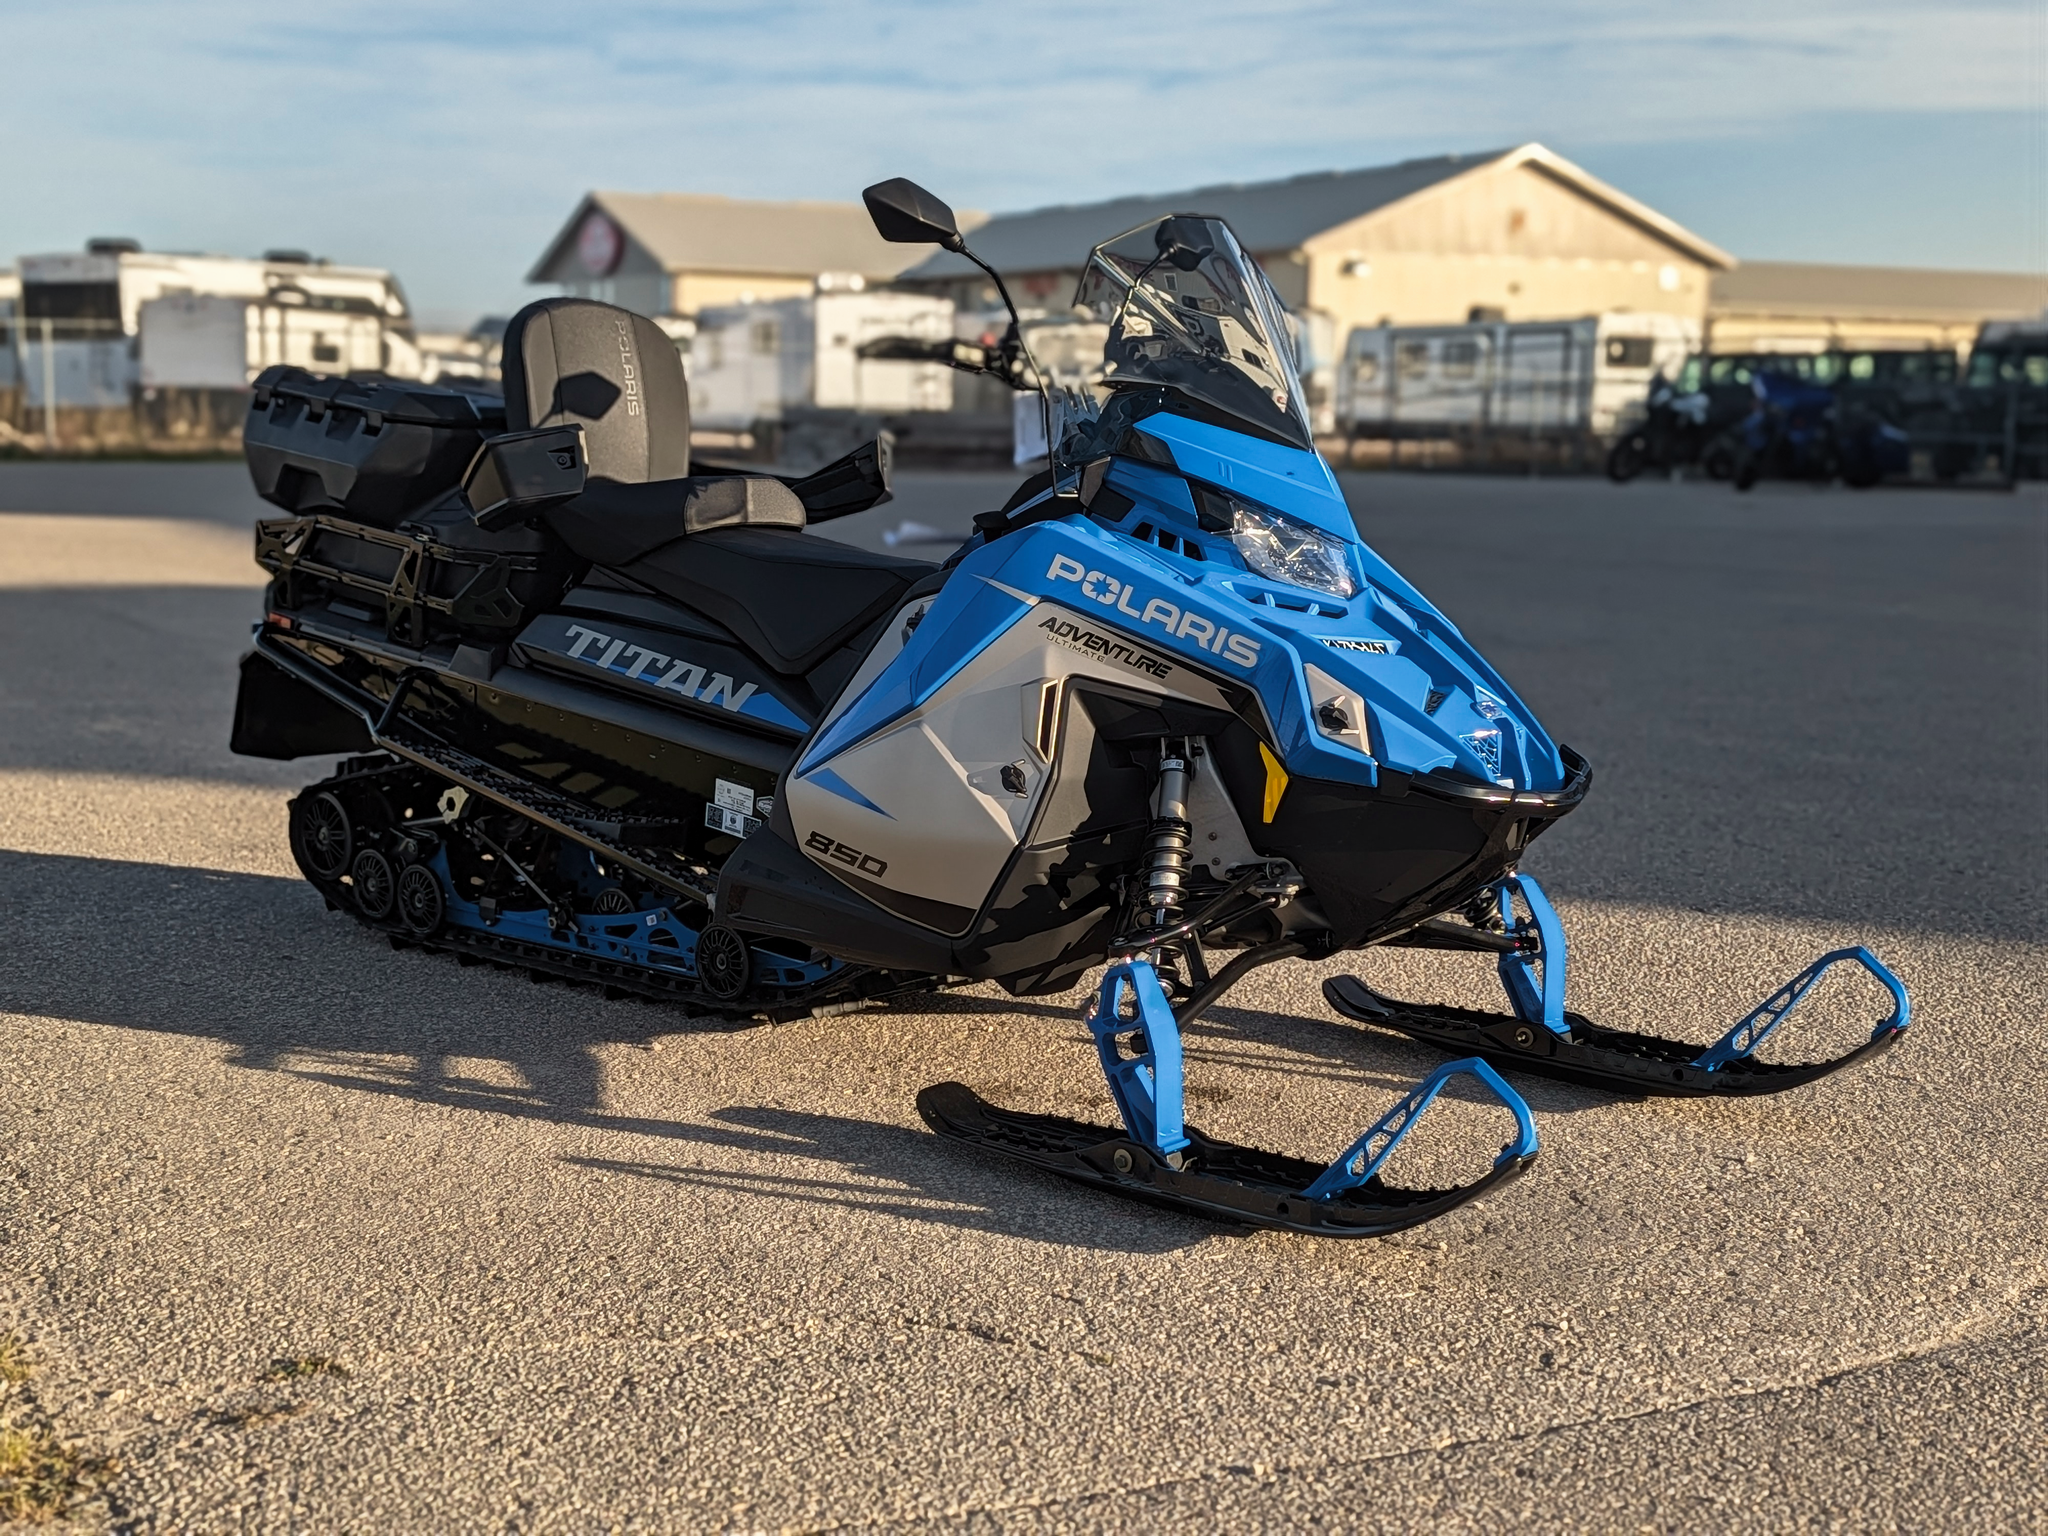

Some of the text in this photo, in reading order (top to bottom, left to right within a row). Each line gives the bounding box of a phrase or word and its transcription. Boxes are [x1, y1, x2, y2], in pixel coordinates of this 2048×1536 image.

[615, 320, 639, 416] POLARIS
[1038, 616, 1173, 679] ADVENTURE
[1046, 553, 1262, 668] POLARIS
[565, 624, 759, 712] TITAN
[804, 830, 888, 878] 850
